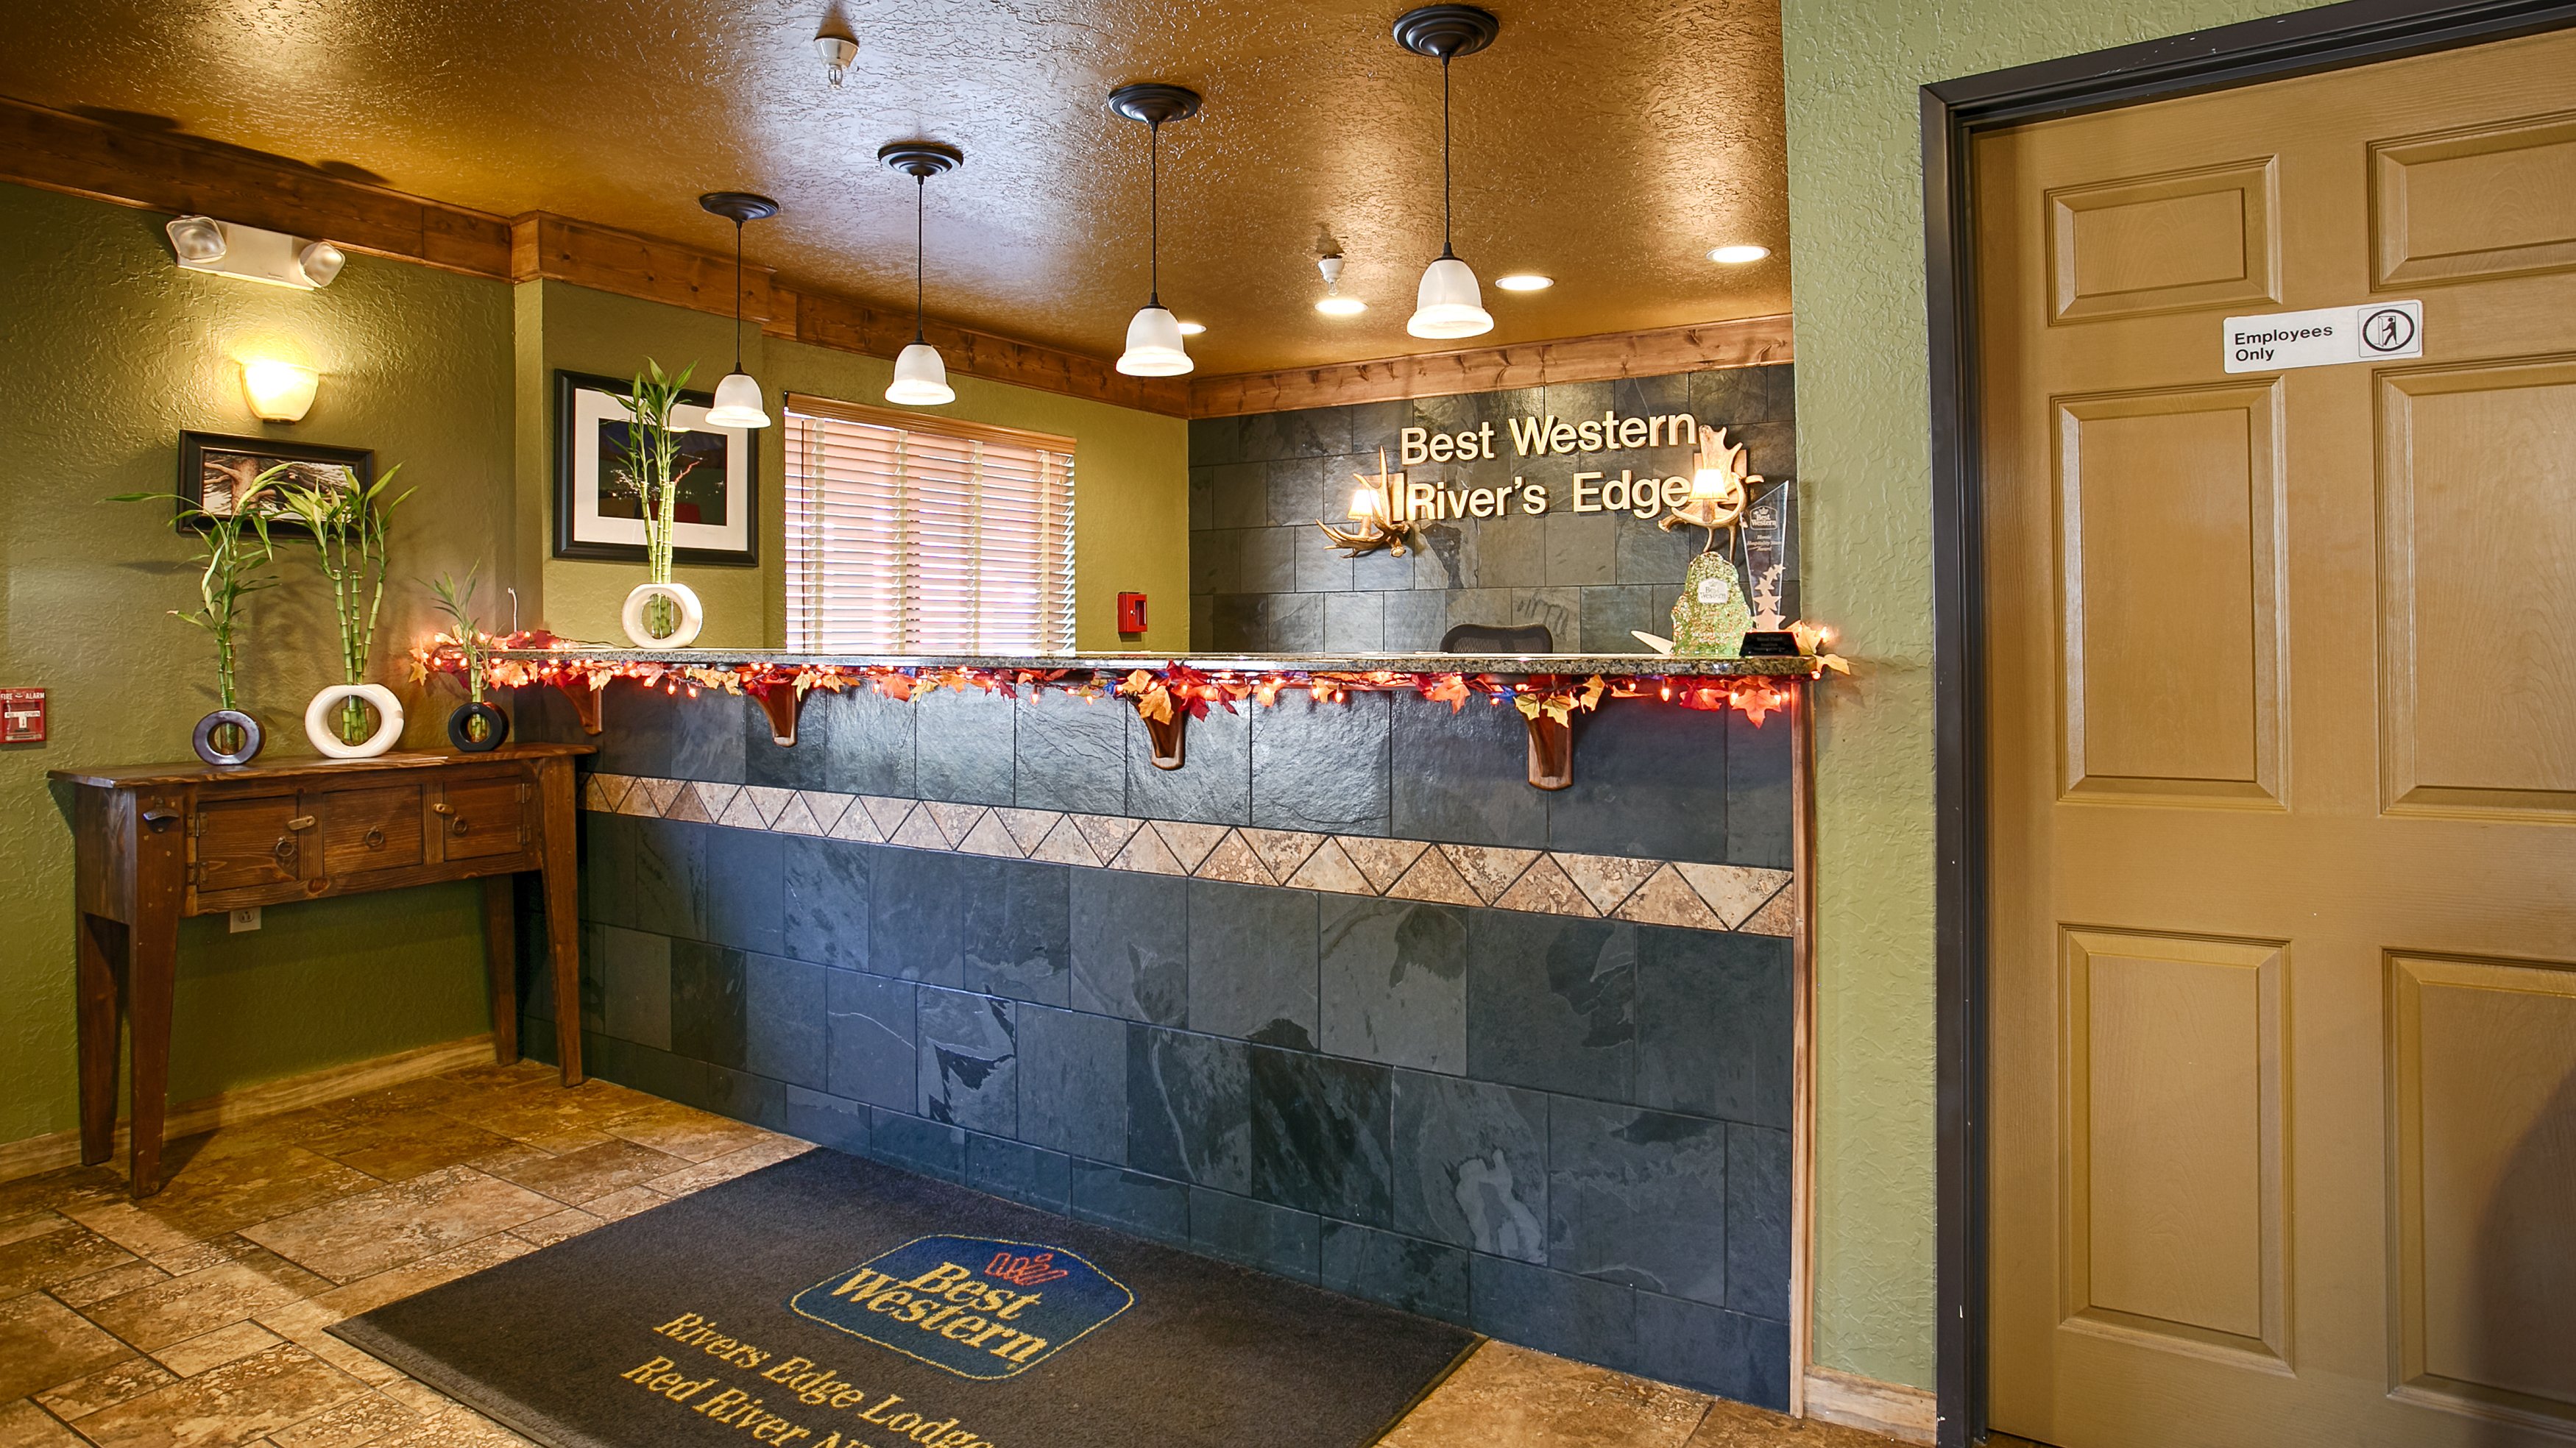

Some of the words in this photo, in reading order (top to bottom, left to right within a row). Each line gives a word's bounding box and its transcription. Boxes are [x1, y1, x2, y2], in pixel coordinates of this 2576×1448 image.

[2234, 326, 2333, 345] Employees
[2234, 347, 2275, 361] Only
[1401, 422, 1496, 465] Best
[1508, 411, 1697, 456] Western
[1406, 476, 1547, 521] River's
[1573, 469, 1691, 519] Edge
[830, 1267, 1048, 1363] Western
[898, 1261, 1043, 1320] Best
[652, 1312, 771, 1369] Rivers
[760, 1355, 865, 1408] Edge
[620, 1355, 720, 1403] Red
[692, 1387, 811, 1448] River
